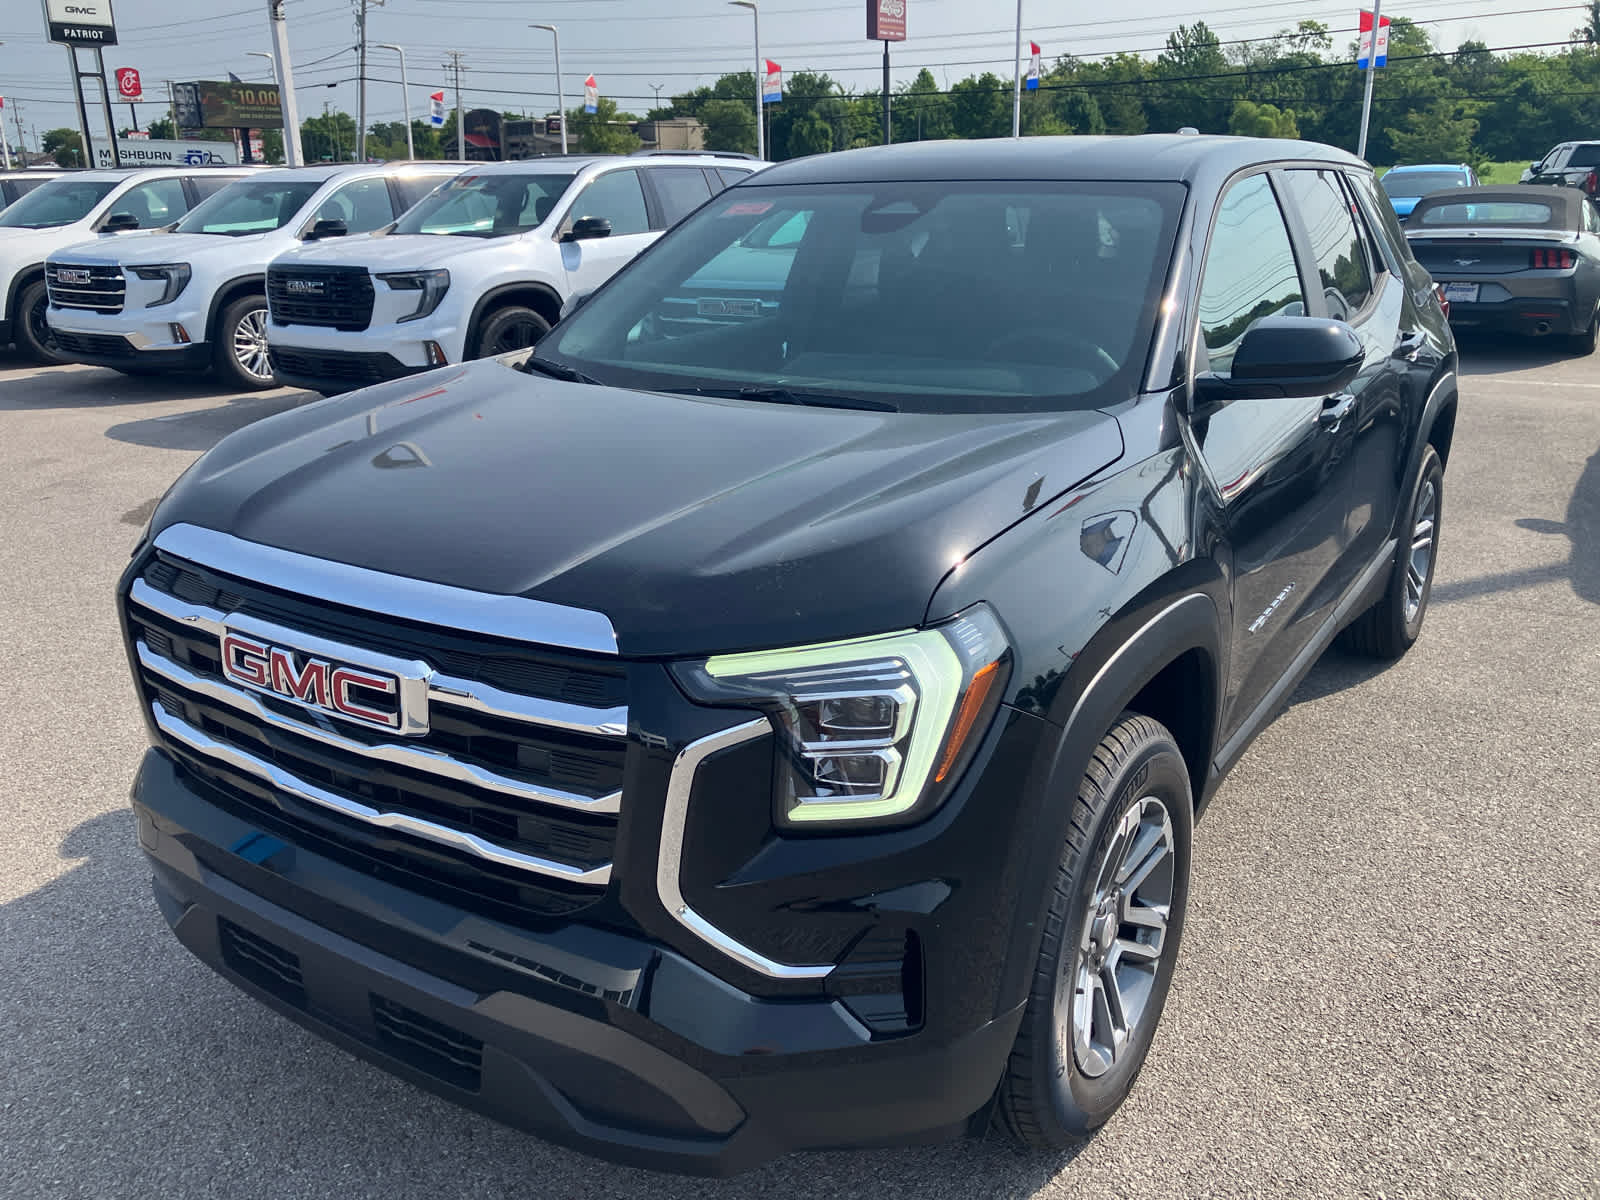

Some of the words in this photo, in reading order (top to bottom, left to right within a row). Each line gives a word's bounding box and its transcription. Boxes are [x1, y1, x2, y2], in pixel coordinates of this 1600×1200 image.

[65, 6, 97, 15] GMC
[63, 28, 104, 40] PATRIOT
[99, 150, 172, 160] MSHBURN
[287, 280, 324, 294] GMC
[223, 632, 400, 728] GMC
